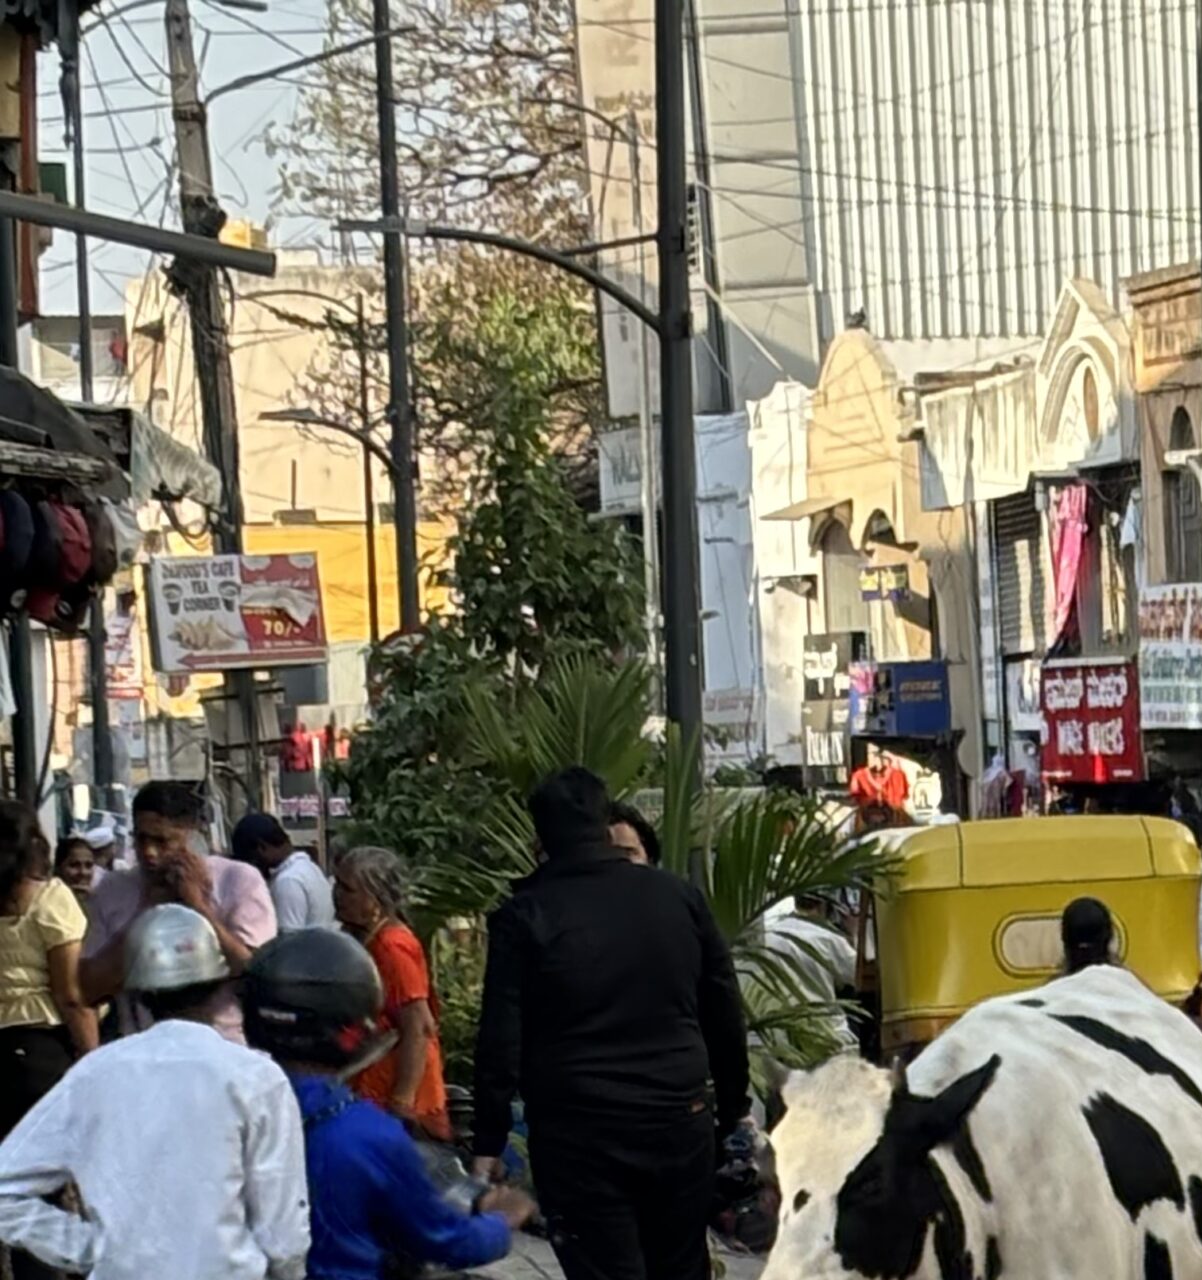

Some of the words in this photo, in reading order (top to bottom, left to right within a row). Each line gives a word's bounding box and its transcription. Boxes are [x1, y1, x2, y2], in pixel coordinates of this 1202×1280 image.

[211, 560, 235, 578] CAFE
[191, 580, 210, 594] TEA
[183, 596, 222, 613] CORNER
